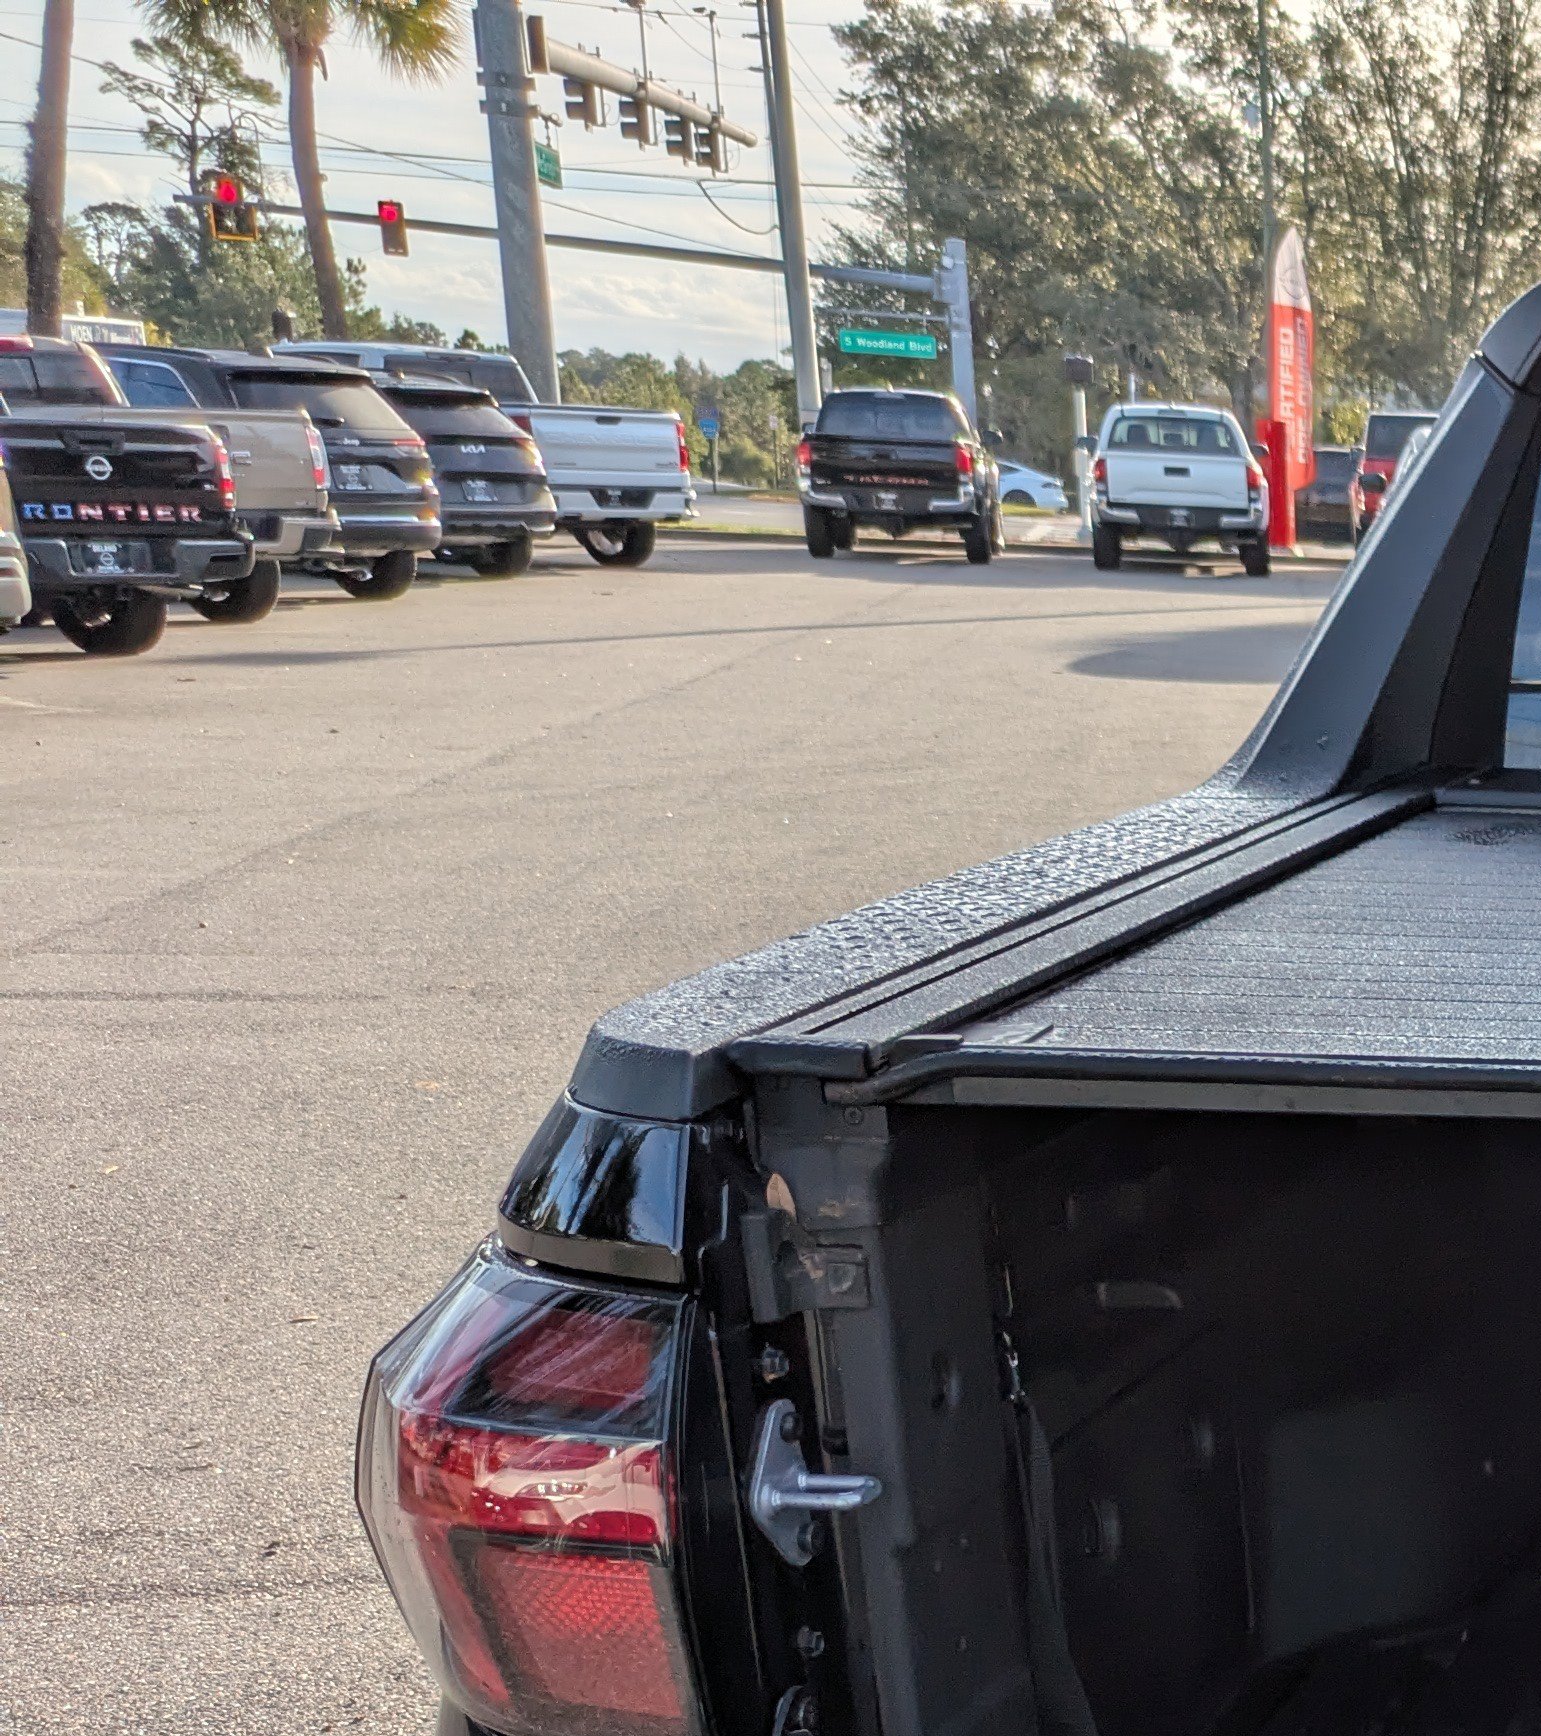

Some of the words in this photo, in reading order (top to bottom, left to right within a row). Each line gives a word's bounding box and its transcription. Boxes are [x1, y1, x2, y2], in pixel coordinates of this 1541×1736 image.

[844, 336, 853, 347] S
[856, 337, 905, 351] Woodland
[909, 341, 932, 353] Blvd
[21, 502, 202, 522] RONTIER
